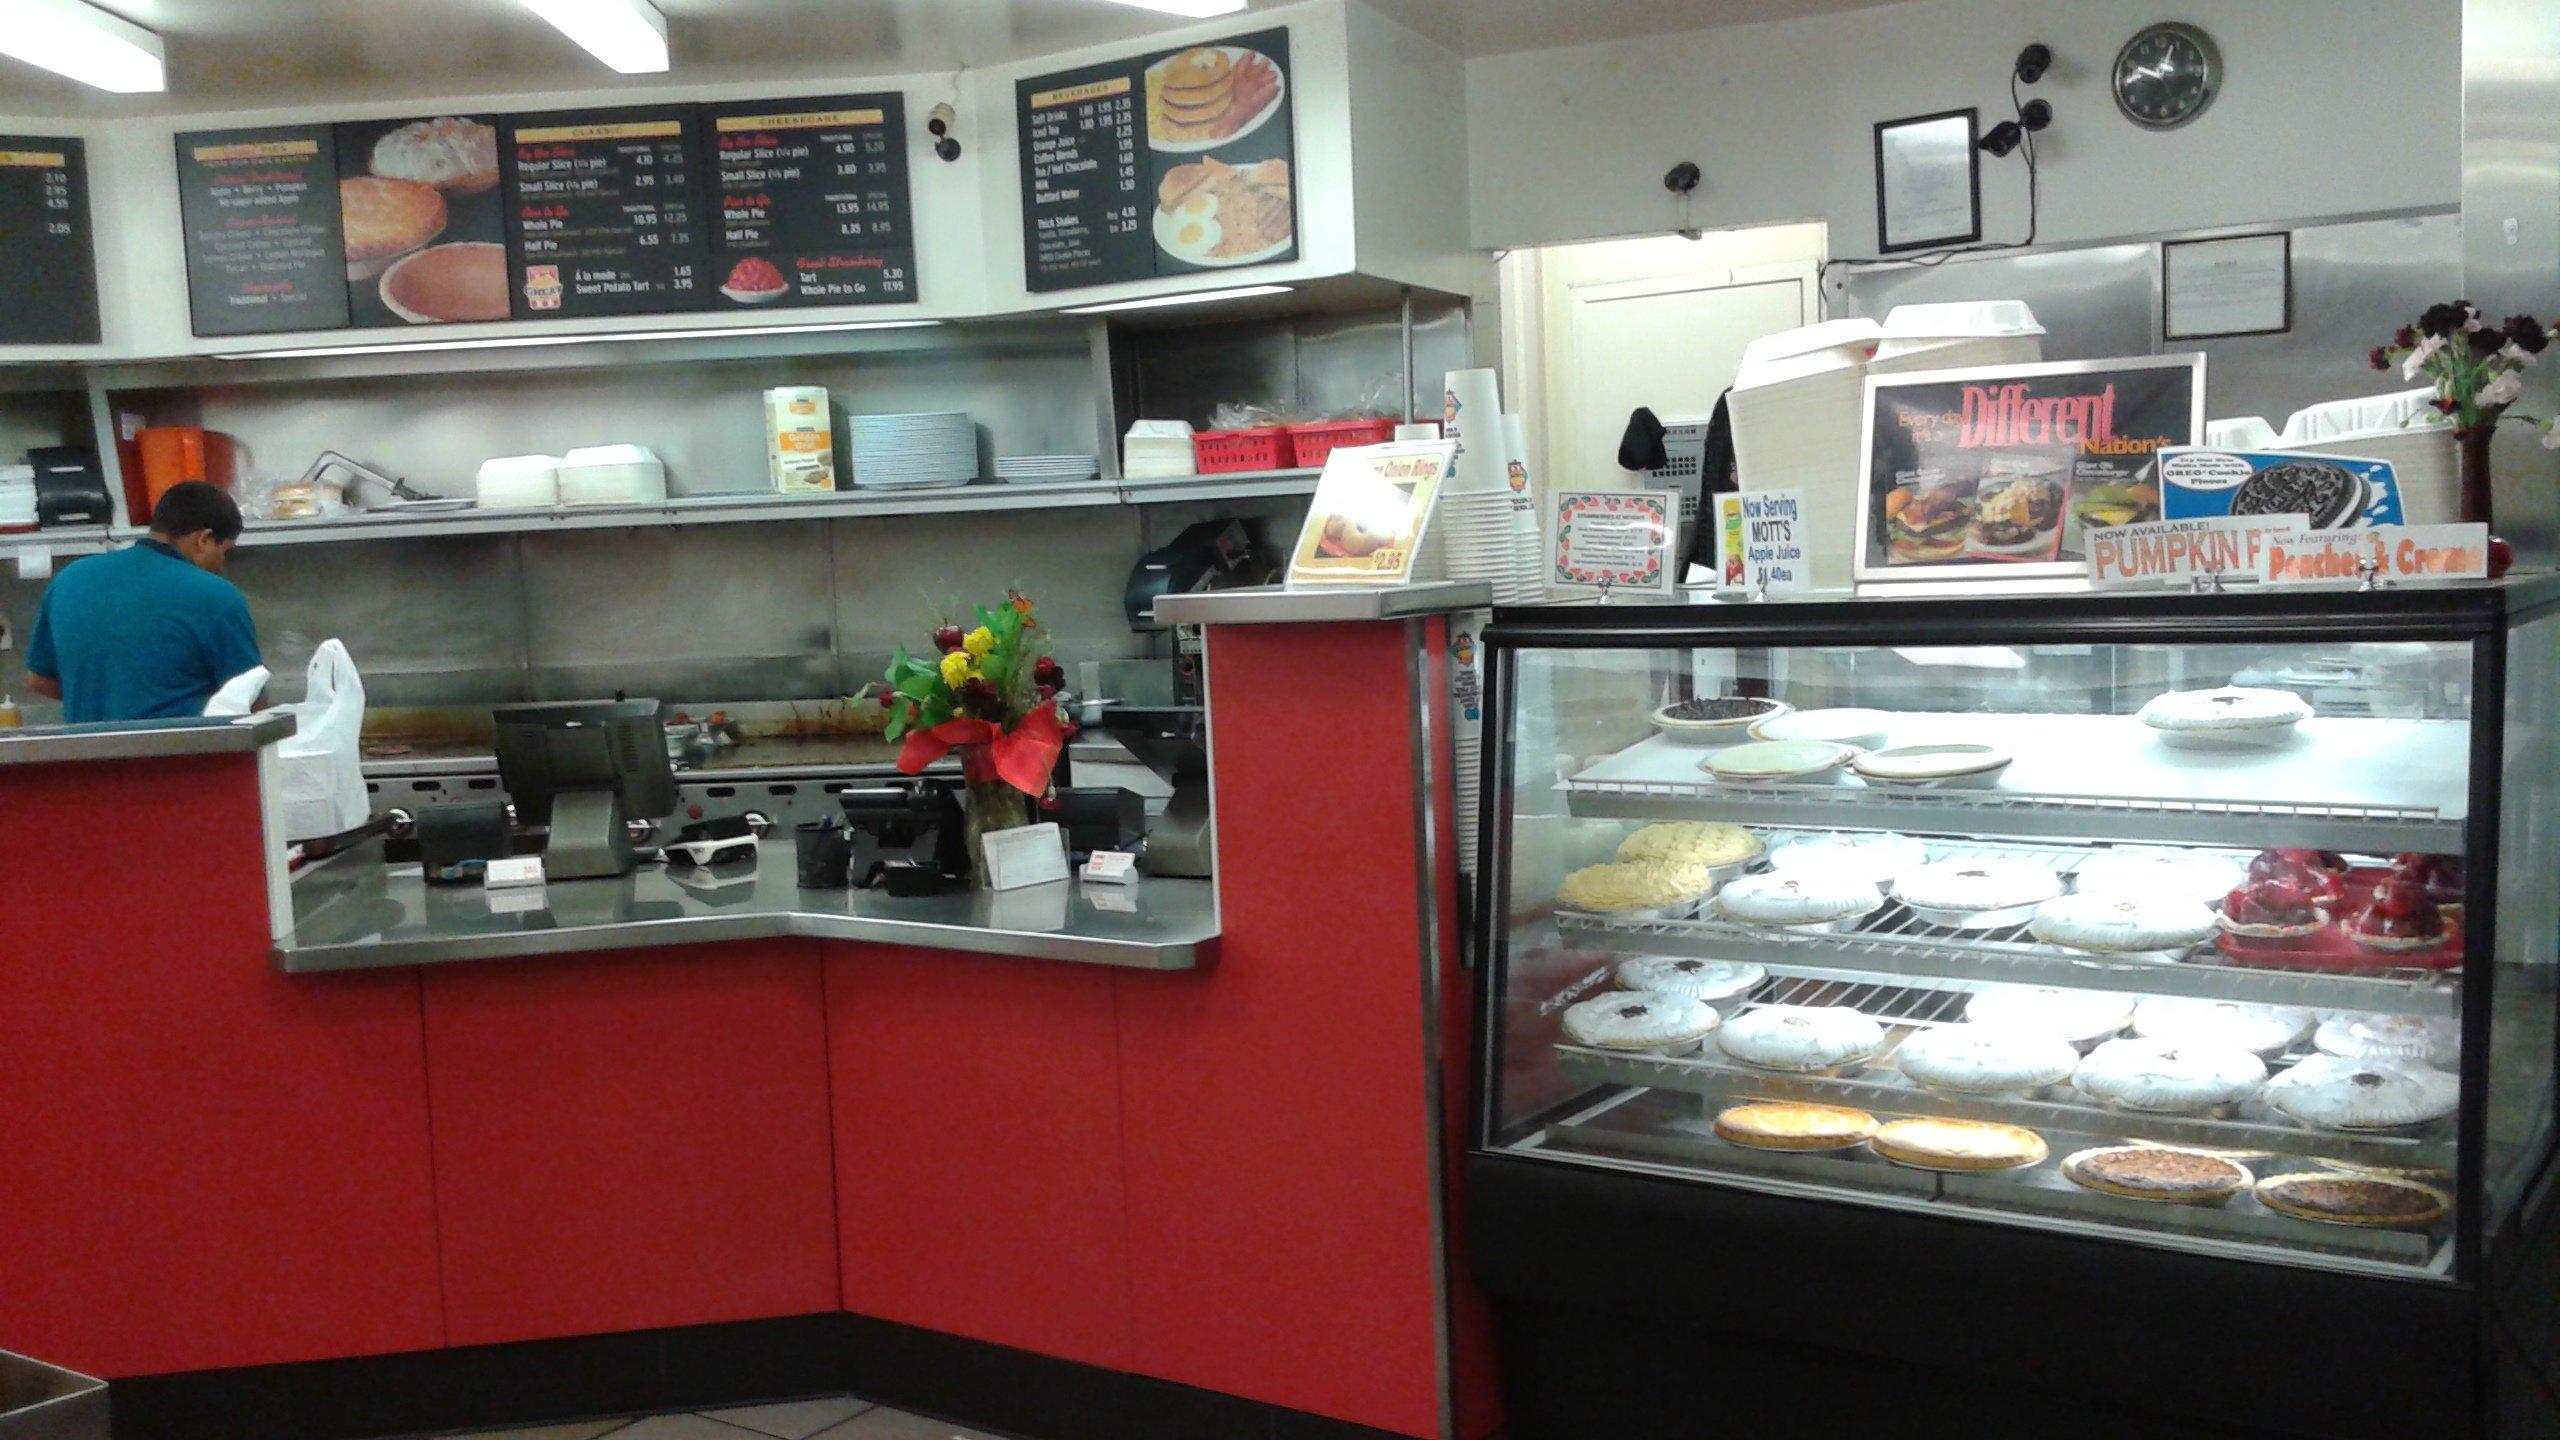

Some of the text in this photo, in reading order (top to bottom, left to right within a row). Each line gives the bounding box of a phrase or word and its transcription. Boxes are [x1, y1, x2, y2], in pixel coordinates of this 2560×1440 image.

[1052, 85, 1108, 100] BEVERAGES
[759, 115, 839, 126] CHEESECAKE
[1032, 113, 1046, 125] Soft
[1046, 111, 1068, 122] Drinks
[1032, 126, 1047, 139] Iced
[1048, 125, 1060, 136] Tea
[1033, 140, 1057, 152] Orange
[1058, 136, 1075, 148] Juice
[719, 151, 751, 162] Regular
[754, 149, 774, 159] Slice
[792, 146, 809, 158] pie)
[1034, 153, 1055, 165] Coffee
[517, 160, 550, 172] Regular
[551, 158, 572, 171] Slice
[1065, 159, 1098, 173] Chocolate
[721, 171, 745, 182] Small
[746, 169, 766, 180] Slice
[520, 181, 543, 193] Small
[544, 180, 564, 192] Slice
[723, 209, 750, 220] Whole
[751, 208, 766, 218] Pie
[837, 203, 860, 214] 13.95
[523, 219, 548, 231] Whole
[550, 218, 564, 230] Pie
[634, 213, 658, 225] 10.95
[726, 230, 743, 241] Half
[745, 229, 759, 239] Pie
[524, 240, 542, 252] Half
[543, 240, 558, 250] Pie
[828, 255, 883, 268] Strawberry
[800, 268, 903, 282] Tart 5.30
[576, 282, 601, 294] Sweet
[603, 282, 632, 293] Potato
[633, 281, 650, 291] Tart
[673, 278, 693, 289] 3.95
[801, 285, 826, 295] Whole
[828, 283, 841, 294] Pie
[843, 284, 853, 293] to
[854, 283, 866, 293] Go
[1898, 411, 1939, 427] Every
[1959, 383, 2115, 447] Different
[2080, 436, 2171, 455] Nation's
[1384, 460, 1411, 478] Onion
[1411, 459, 1439, 480] Rings
[1742, 494, 1797, 521] Now Serving
[1752, 520, 1791, 542] MOTT'S
[2094, 521, 2210, 541] NOW AVAILABLE!
[2273, 536, 2293, 545] Now
[1748, 545, 1800, 564] Apple Juice
[2095, 530, 2239, 580] PUMPKIN
[2269, 543, 2363, 580] Peaches
